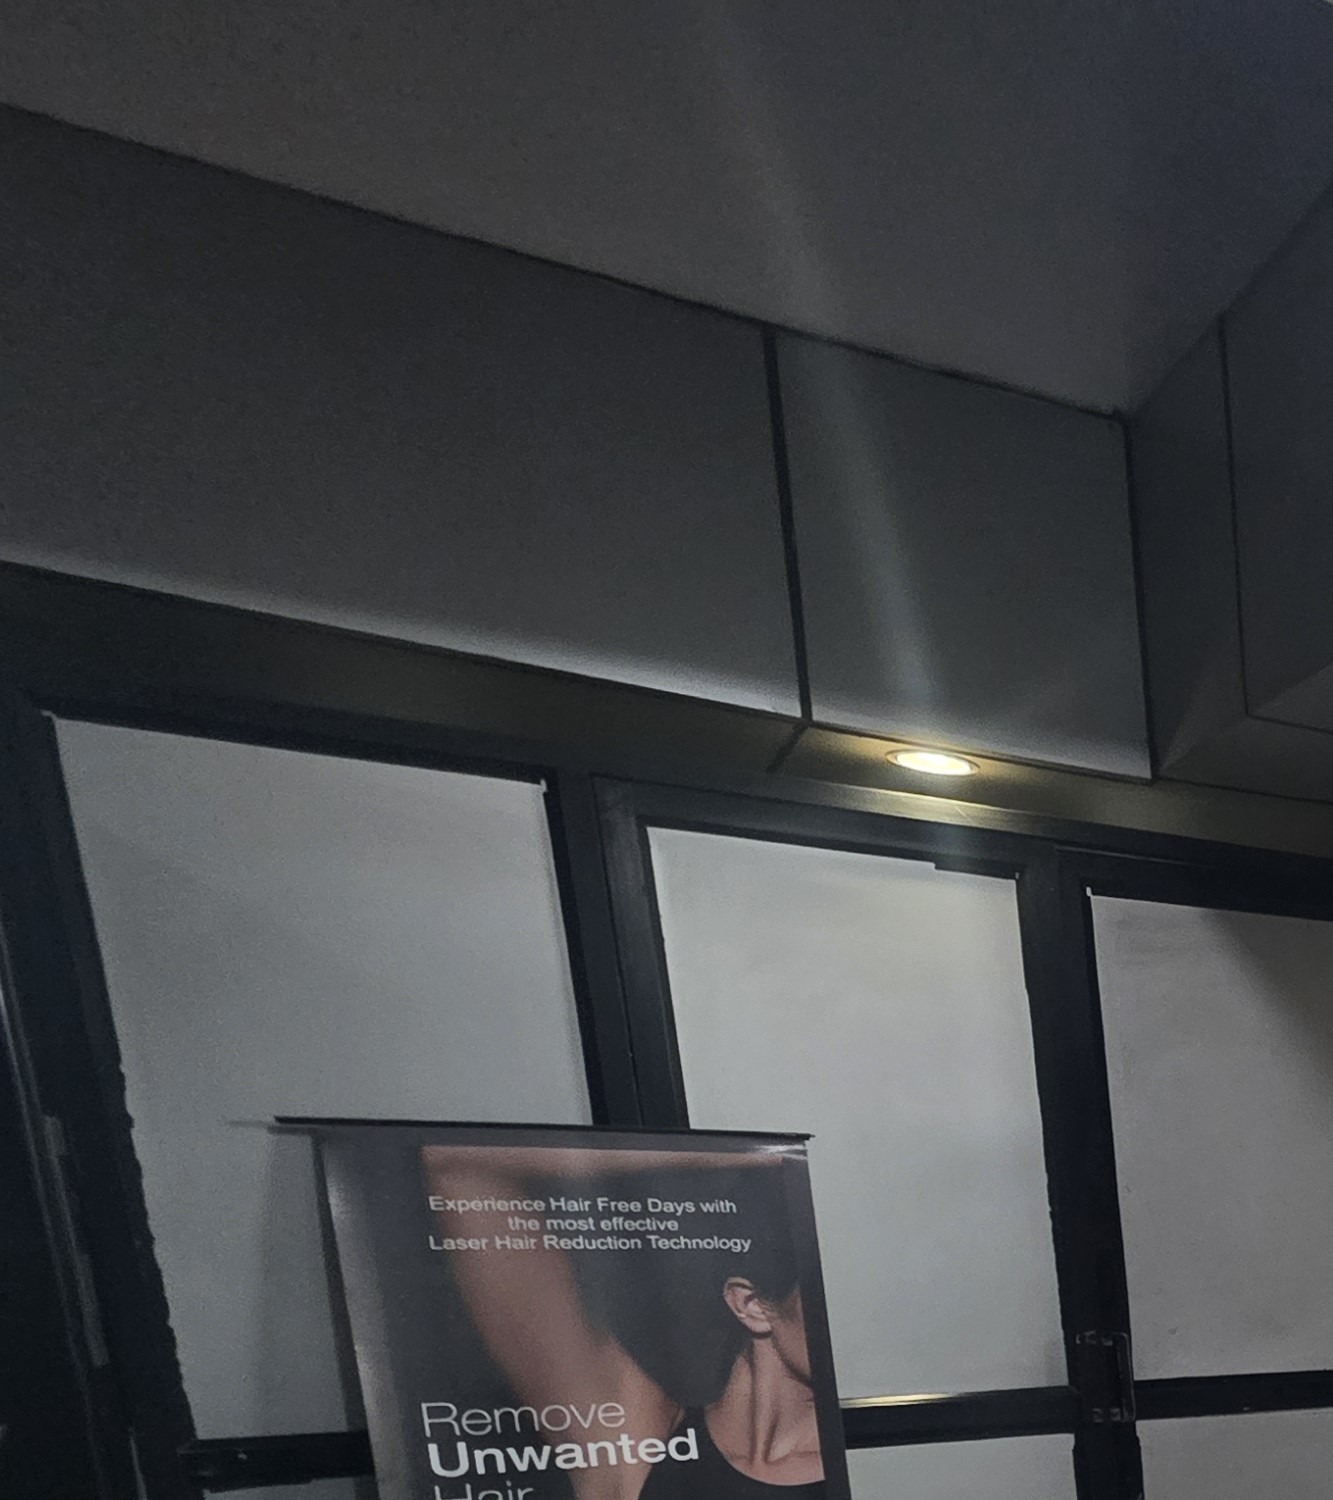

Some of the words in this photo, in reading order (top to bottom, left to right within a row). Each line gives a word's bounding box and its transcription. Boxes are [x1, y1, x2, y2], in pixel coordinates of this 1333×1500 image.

[428, 1196, 546, 1214] Experience
[549, 1197, 592, 1212] Hair
[596, 1197, 642, 1213] Free
[647, 1198, 696, 1216] Days
[699, 1199, 737, 1213] with
[507, 1216, 540, 1231] the
[546, 1217, 596, 1231] most
[600, 1217, 679, 1232] effective
[428, 1235, 489, 1250] Laser
[494, 1235, 538, 1250] Hair
[543, 1235, 642, 1250] Reduction
[646, 1235, 751, 1253] Technology
[421, 1401, 626, 1438] Remove
[427, 1428, 700, 1478] Unwanted
